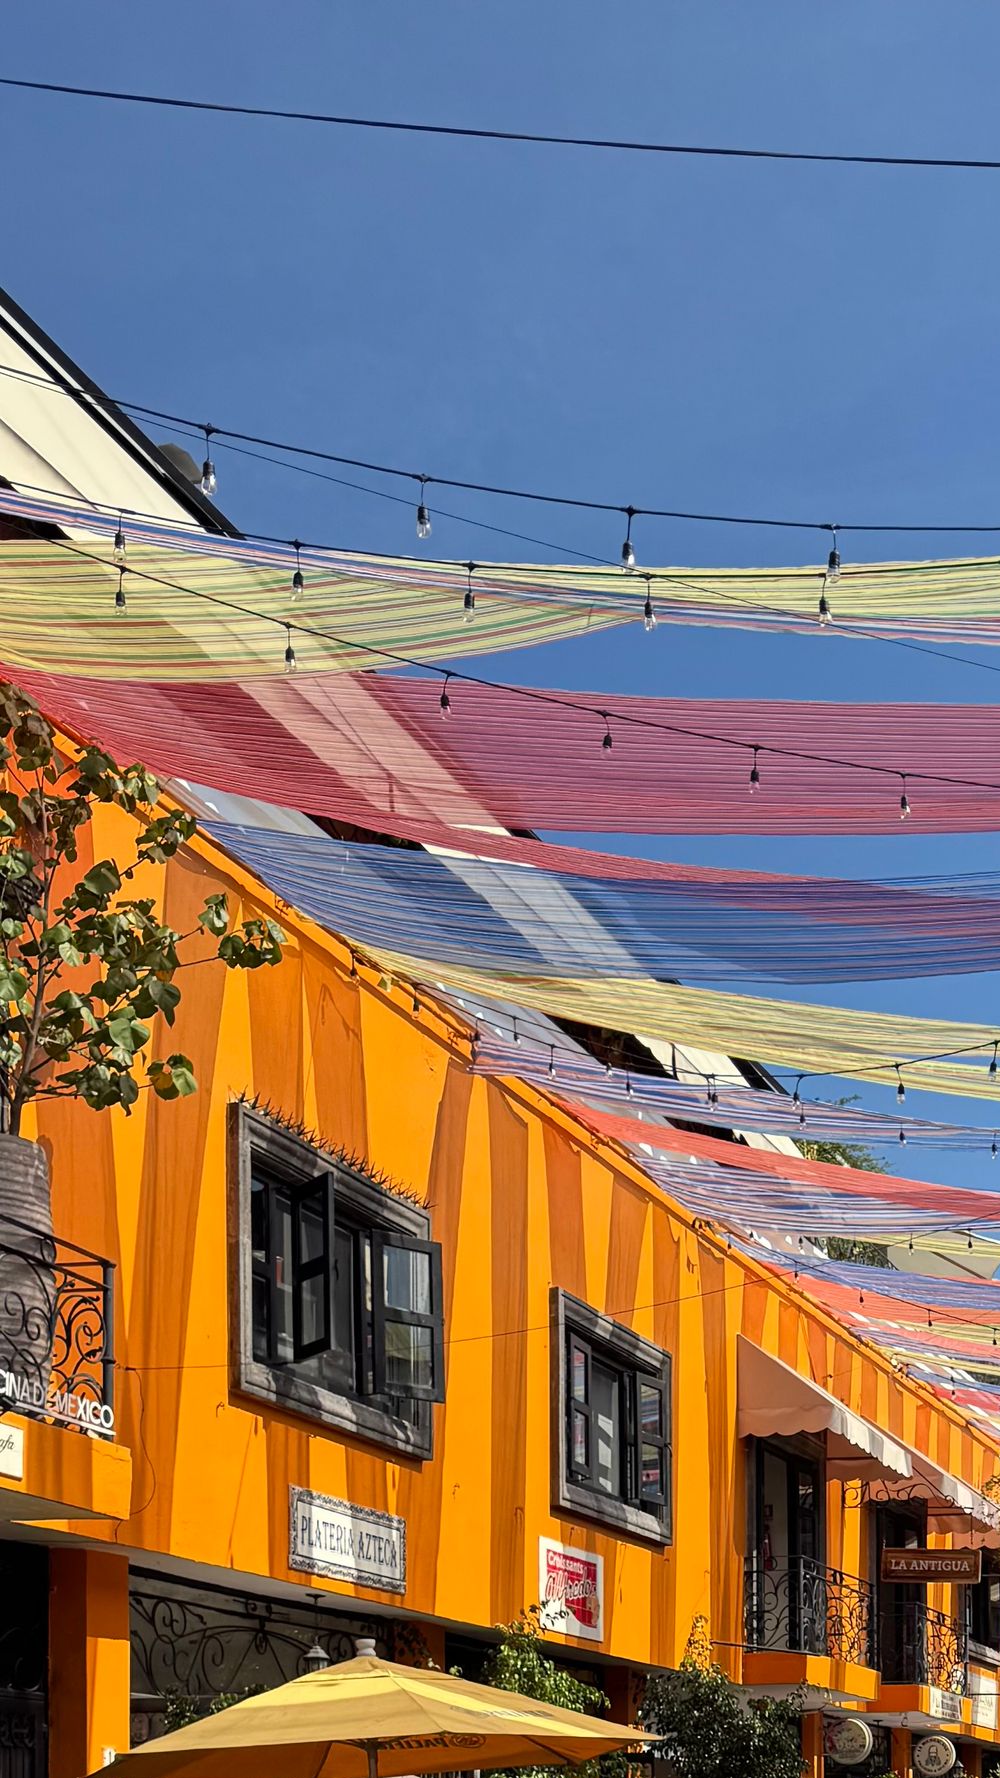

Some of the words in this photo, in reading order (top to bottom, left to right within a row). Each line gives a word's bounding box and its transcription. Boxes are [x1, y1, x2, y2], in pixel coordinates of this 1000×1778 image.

[56, 1389, 114, 1428] MEXICO
[301, 1516, 355, 1556] PLATERIA
[357, 1531, 398, 1568] AZTECA
[890, 1559, 909, 1571] LA
[909, 1560, 970, 1572] ANTIGUA
